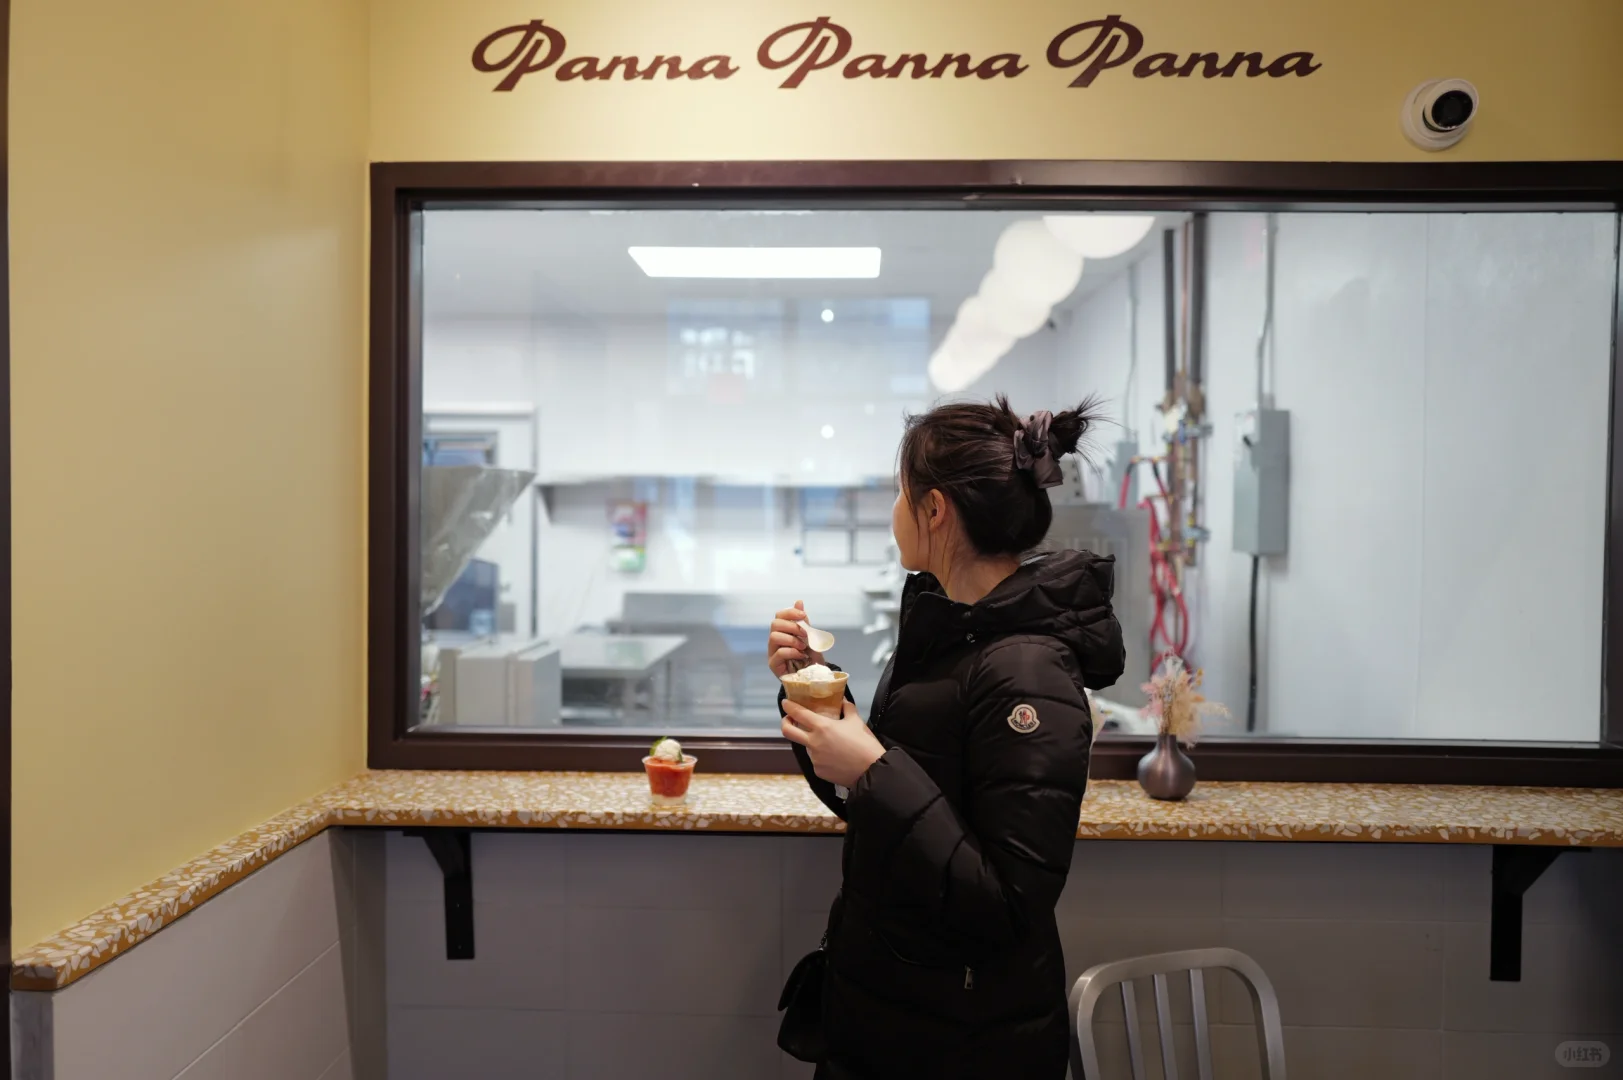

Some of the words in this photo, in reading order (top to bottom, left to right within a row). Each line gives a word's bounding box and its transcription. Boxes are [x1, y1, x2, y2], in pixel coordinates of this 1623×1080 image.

[471, 19, 740, 92] Panna
[757, 16, 1029, 89] Panna
[1046, 14, 1323, 88] Panna
